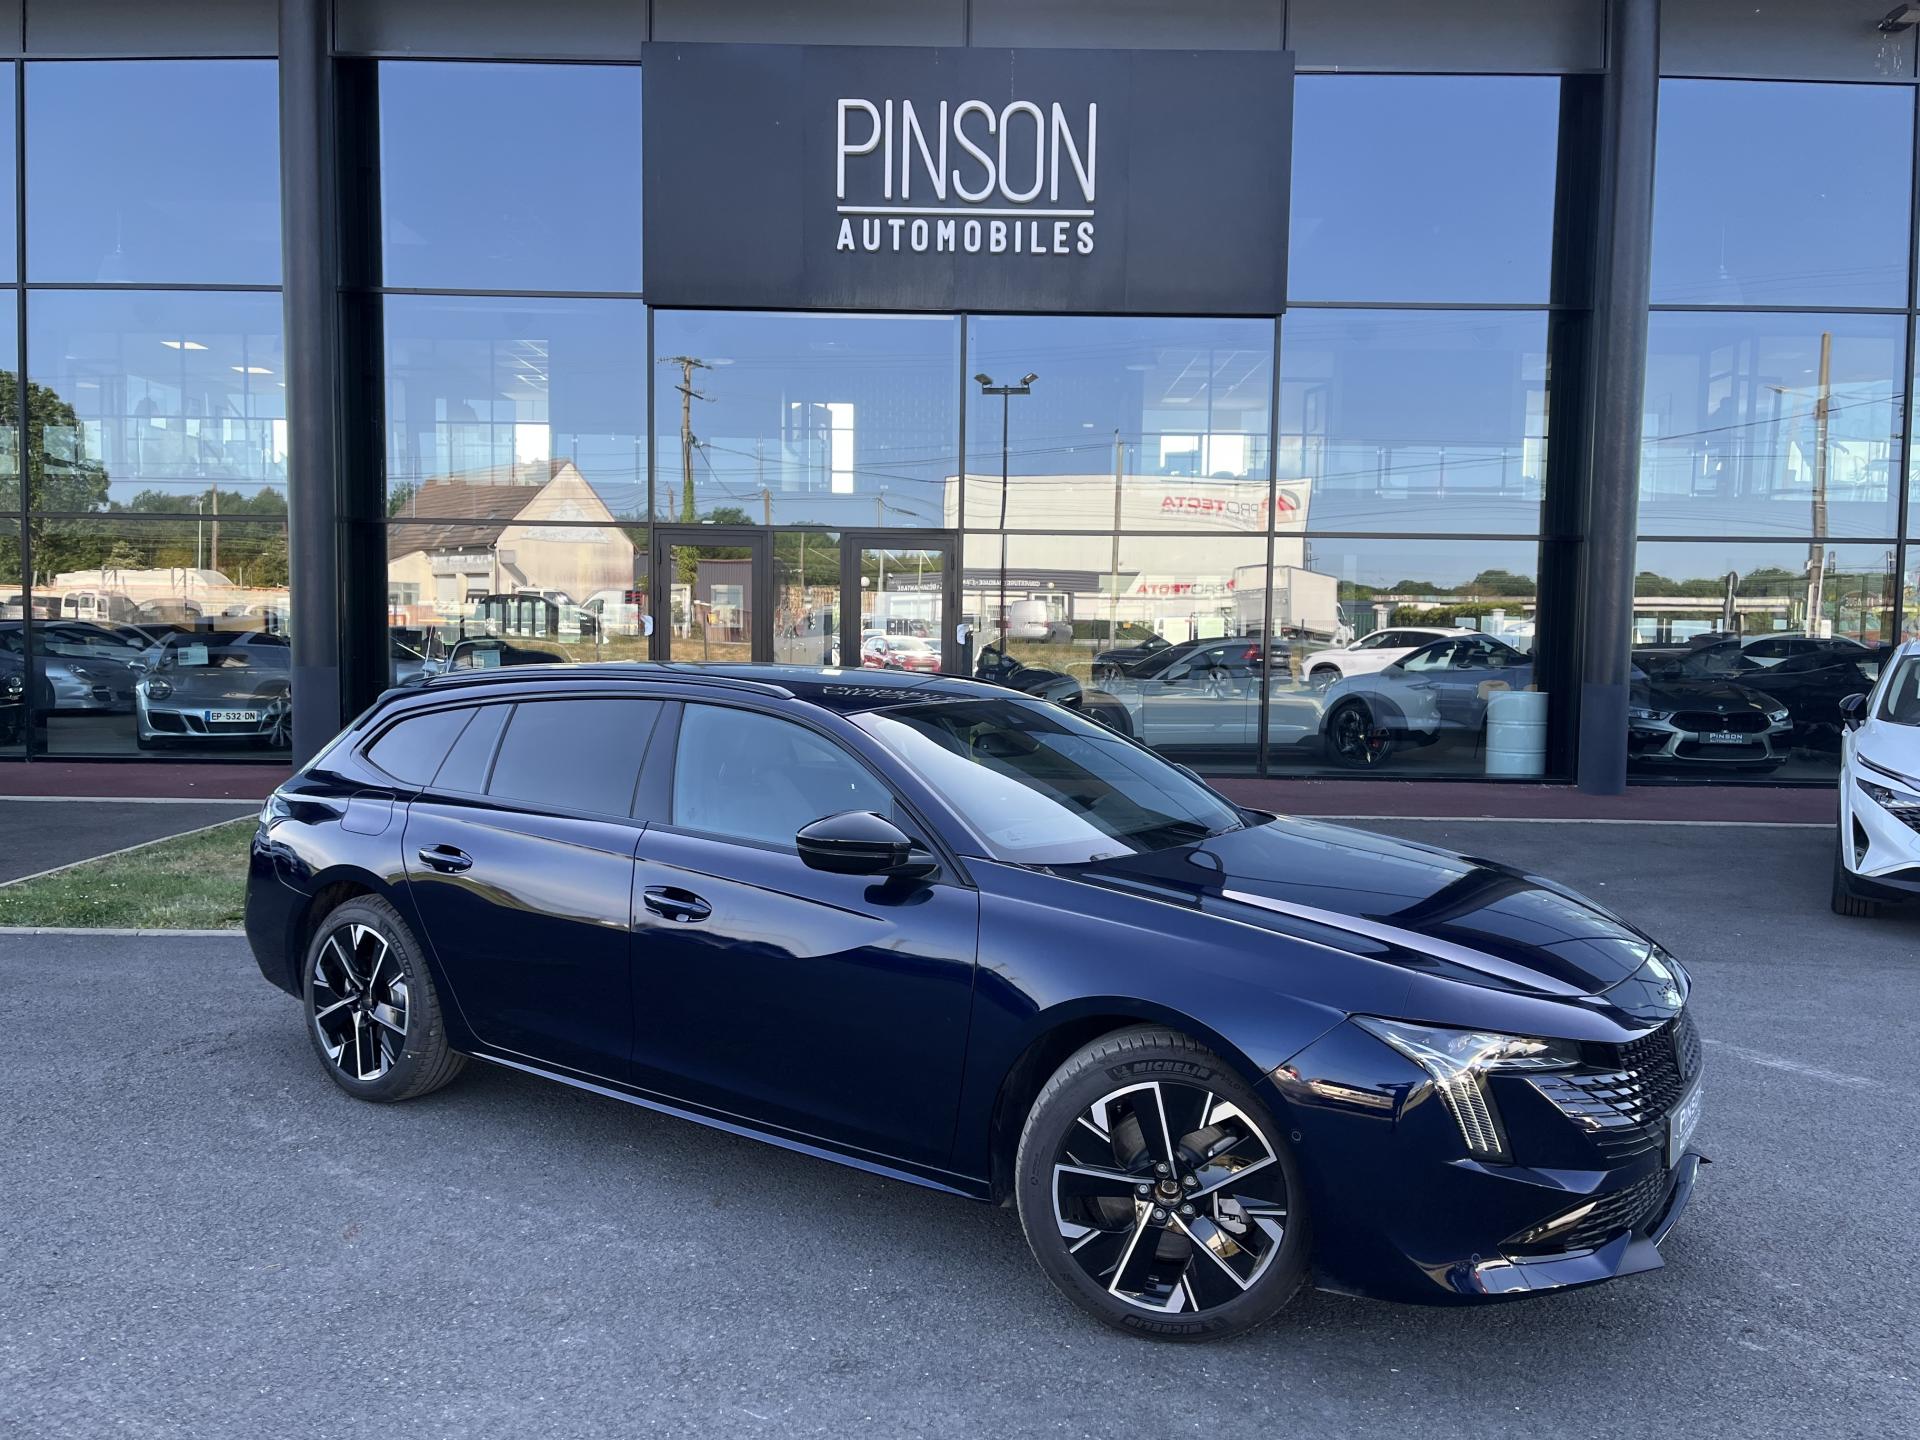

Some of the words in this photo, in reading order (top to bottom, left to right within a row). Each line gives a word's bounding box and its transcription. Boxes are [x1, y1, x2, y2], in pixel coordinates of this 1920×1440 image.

[837, 99, 1097, 202] PINSON
[837, 218, 1095, 254] AUTOMOBILES
[211, 712, 256, 721] EP-532-DN
[1709, 732, 1743, 740] PINSON
[1132, 1060, 1211, 1079] MICHELIN
